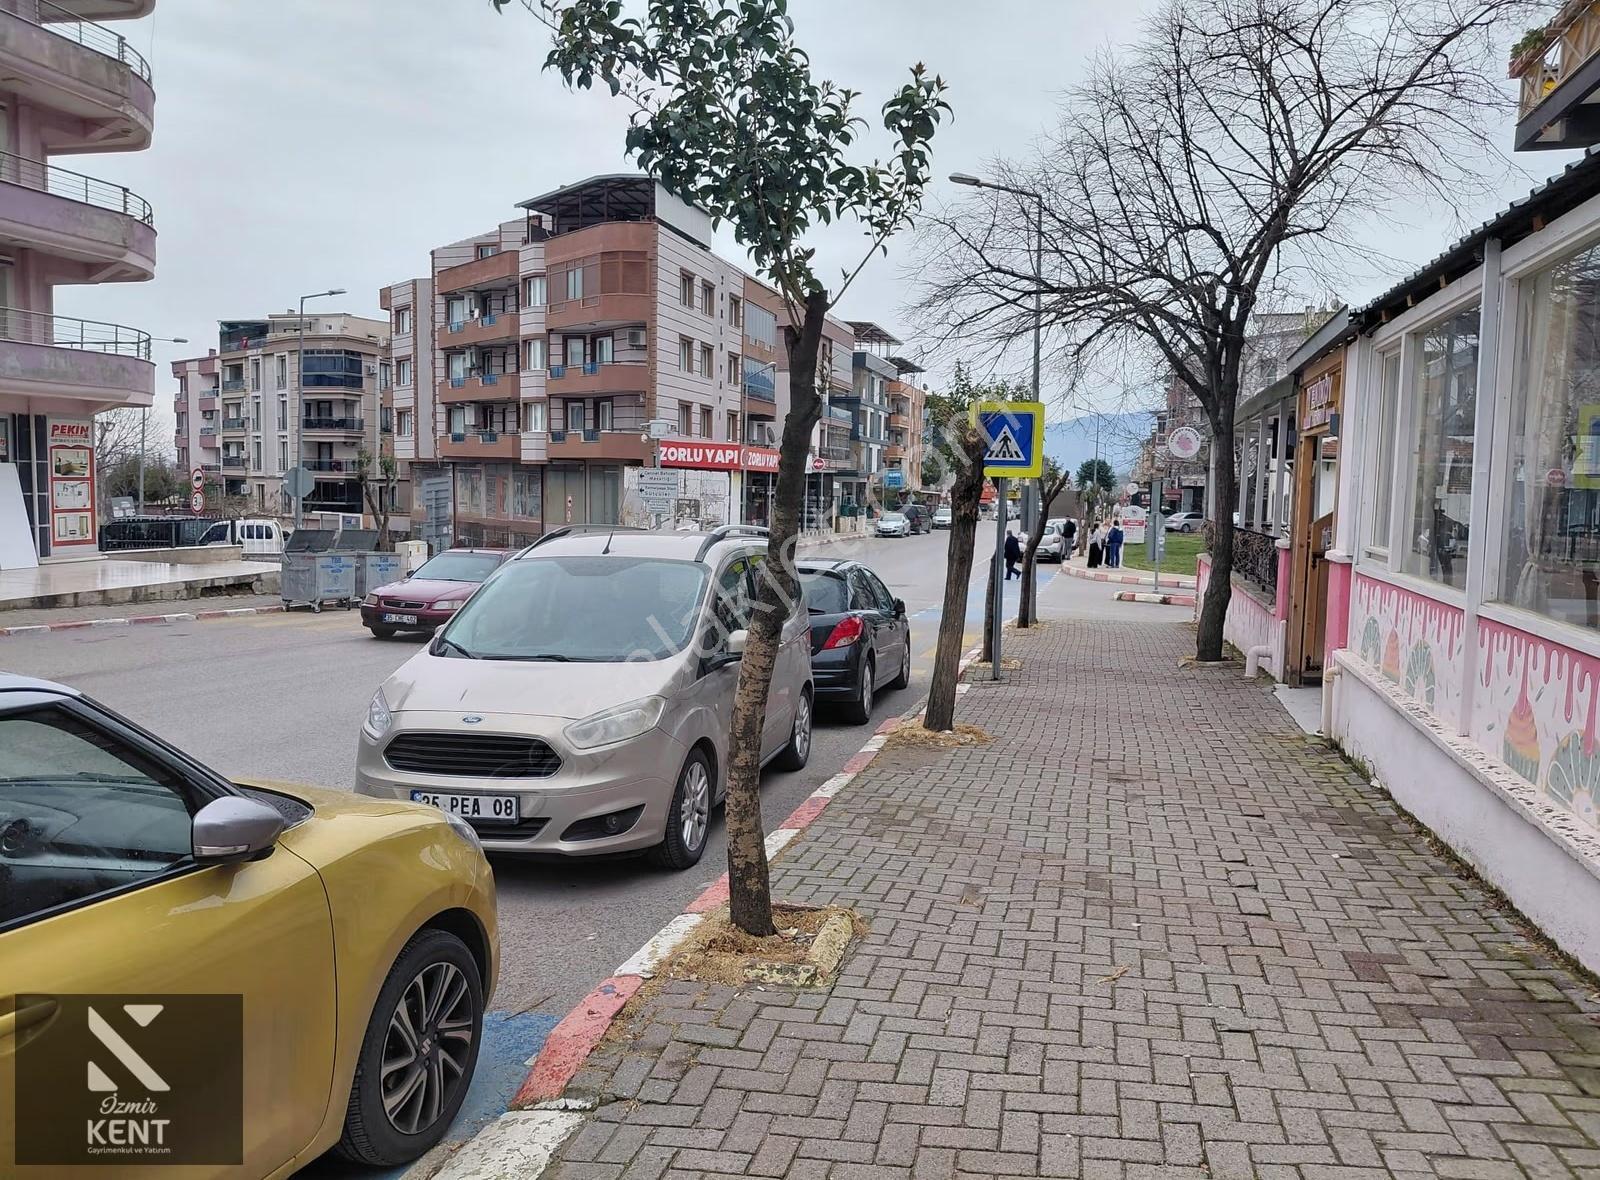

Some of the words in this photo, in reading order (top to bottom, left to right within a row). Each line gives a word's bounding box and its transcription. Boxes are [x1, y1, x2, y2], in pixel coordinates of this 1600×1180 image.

[660, 446, 703, 463] ZORLU
[705, 448, 738, 464] YAPI
[748, 452, 766, 466] ZORLU
[450, 796, 481, 816] PEA
[493, 798, 513, 817] 08
